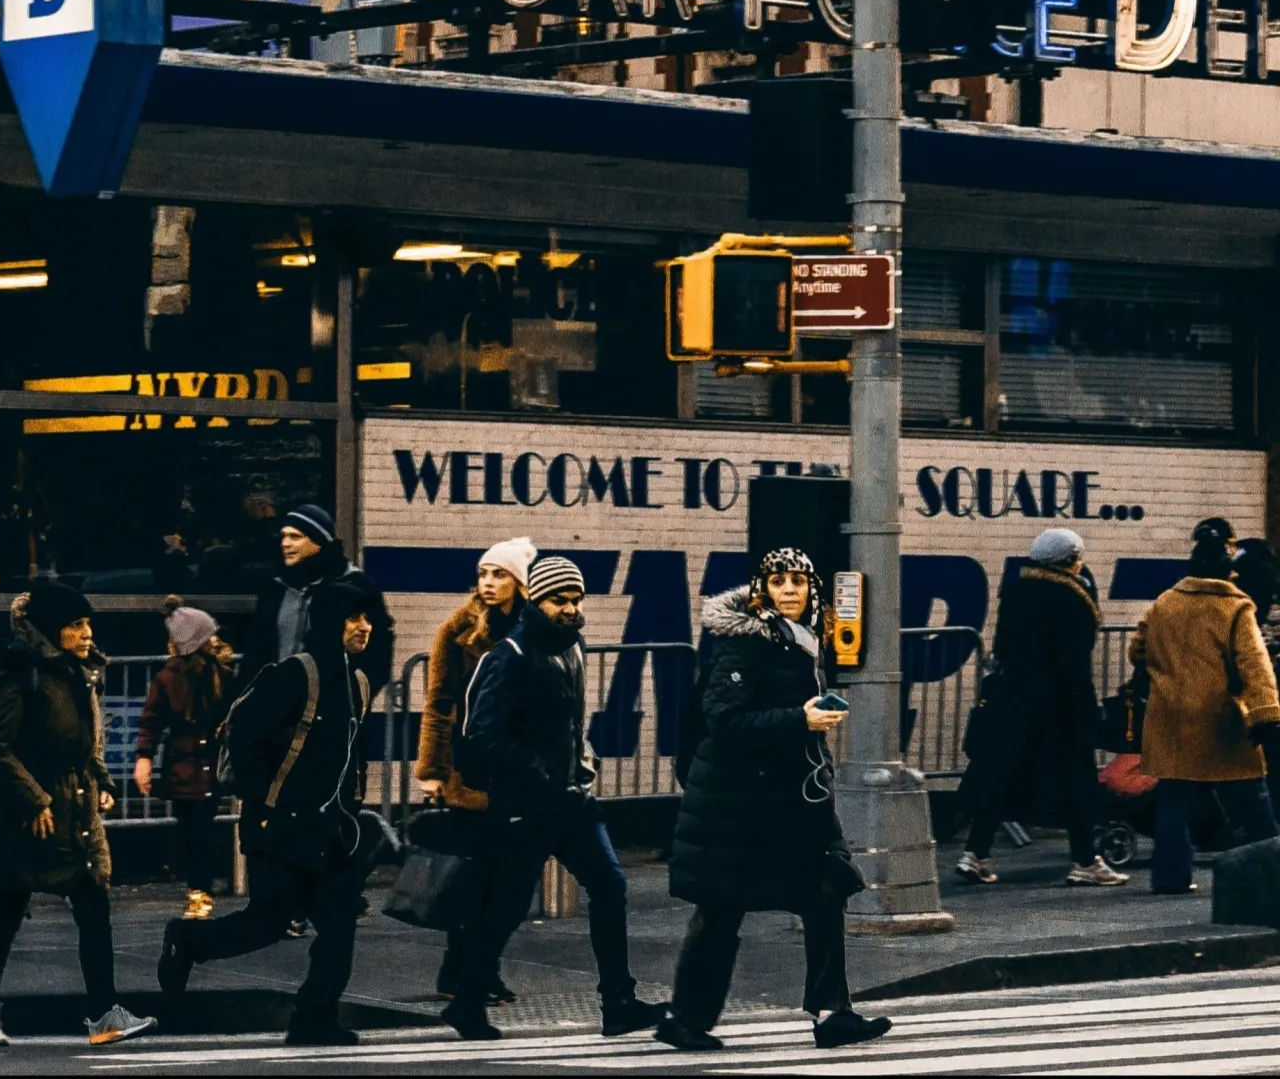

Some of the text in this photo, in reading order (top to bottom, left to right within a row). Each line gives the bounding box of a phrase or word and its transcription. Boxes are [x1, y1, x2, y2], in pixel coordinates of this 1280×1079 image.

[811, 263, 868, 277] STANDING
[130, 368, 290, 430] NYPD
[392, 448, 665, 511] WELCOME
[681, 456, 739, 511] TO
